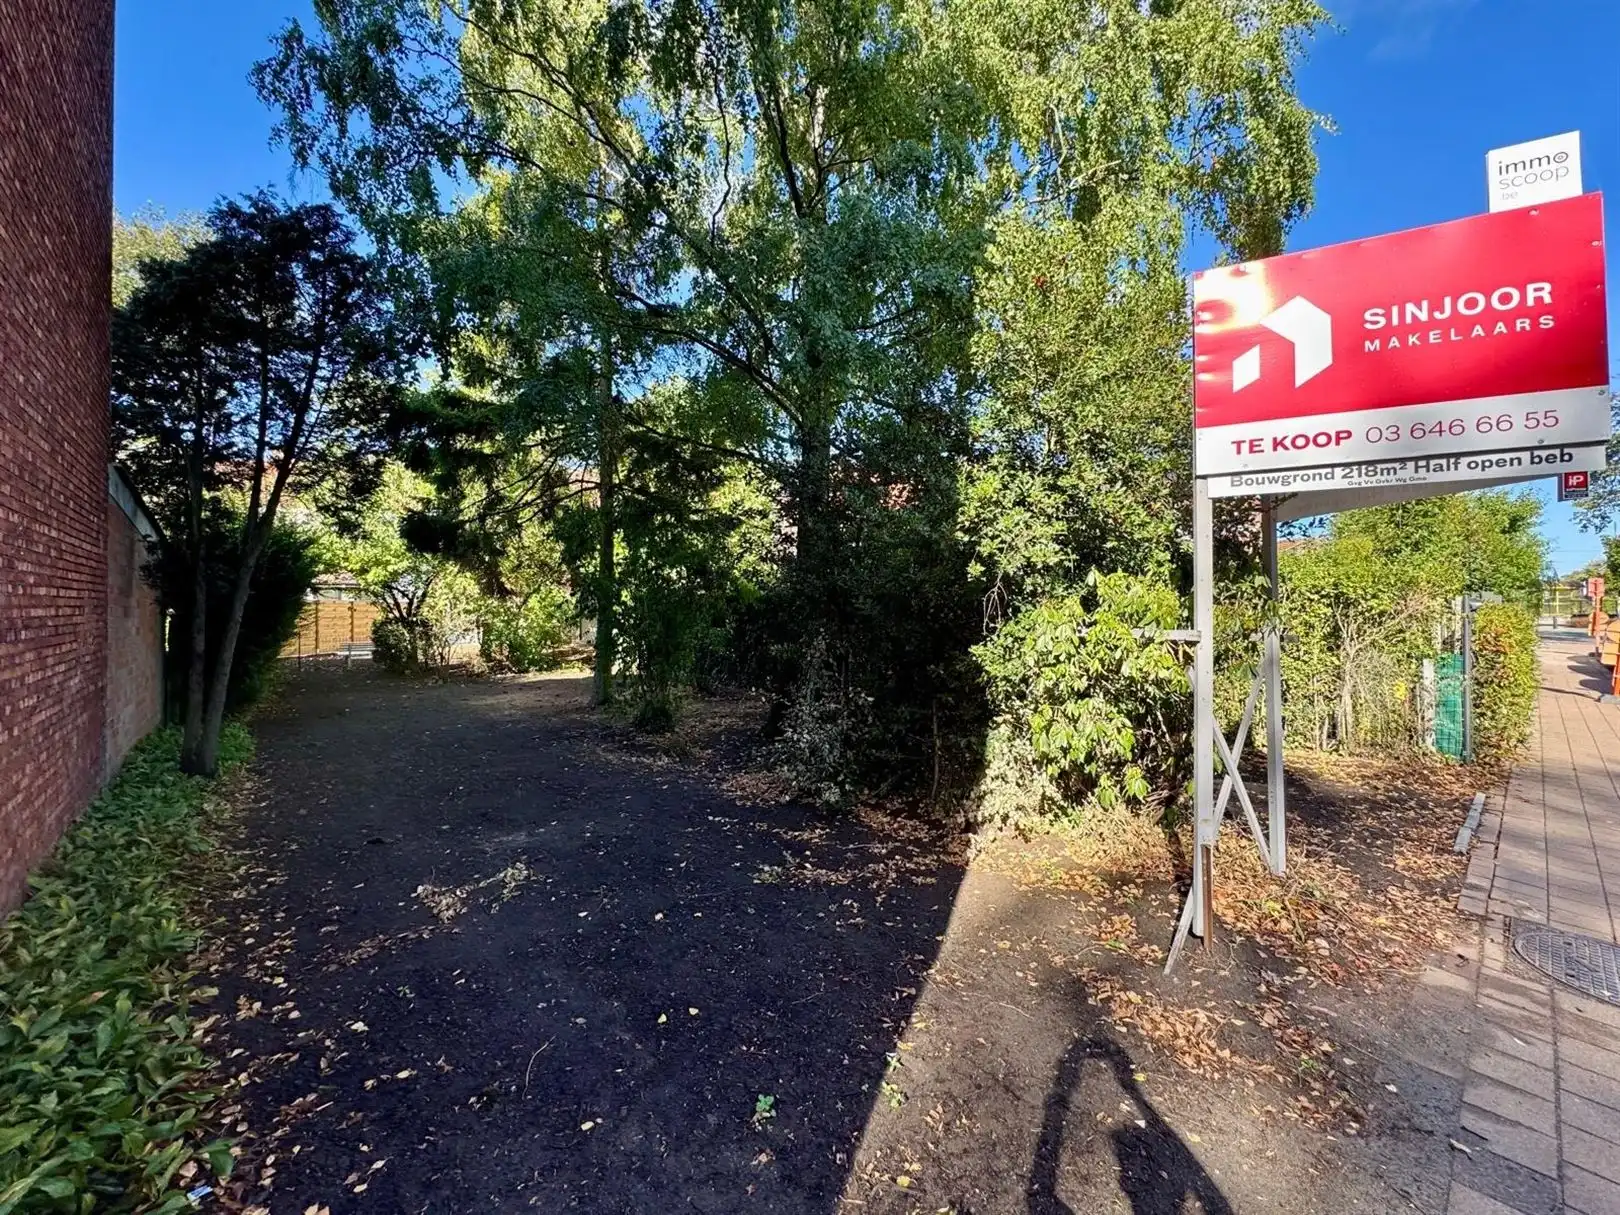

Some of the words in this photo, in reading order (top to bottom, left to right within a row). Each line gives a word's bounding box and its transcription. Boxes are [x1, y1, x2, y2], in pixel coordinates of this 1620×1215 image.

[1498, 166, 1570, 190] scoop
[1363, 281, 1553, 330] SINJOOR
[1364, 315, 1555, 353] MAKELAARS
[1231, 438, 1265, 455] TE
[1272, 429, 1353, 452] KOOP
[1366, 424, 1400, 443] 03
[1410, 419, 1465, 439] 646
[1476, 414, 1513, 433] 66
[1524, 409, 1559, 429] 55
[1230, 468, 1335, 487] Bouwgrond
[1414, 456, 1461, 474] Half
[1467, 454, 1522, 472] open
[1530, 449, 1574, 465] beb
